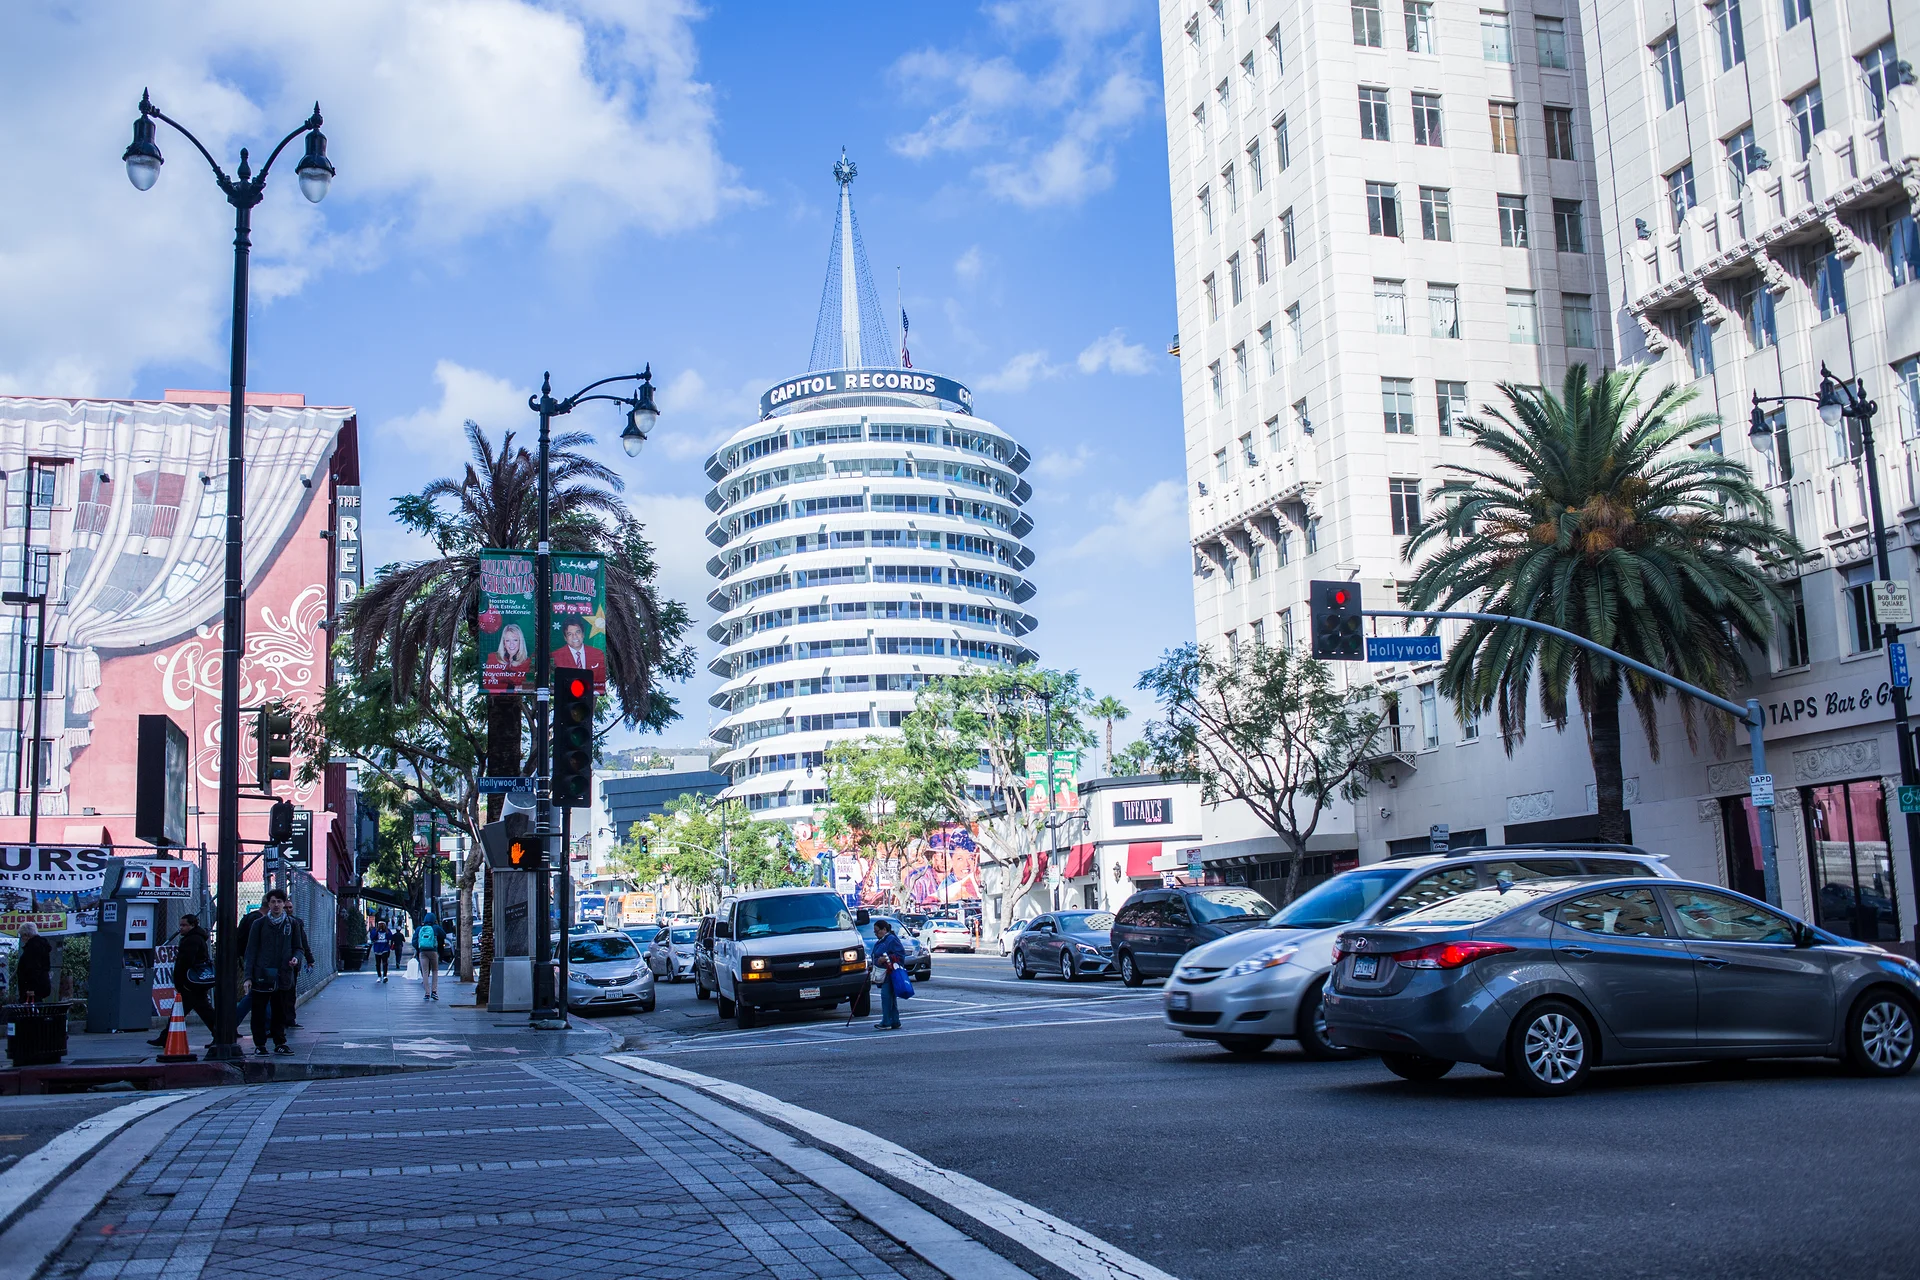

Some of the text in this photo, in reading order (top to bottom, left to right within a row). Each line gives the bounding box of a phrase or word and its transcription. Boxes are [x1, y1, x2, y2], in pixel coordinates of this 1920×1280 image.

[770, 373, 936, 405] CAPITOL RECORDS
[338, 495, 360, 508] THE
[480, 559, 533, 577] HOLLYWOOD
[480, 572, 535, 595] CHRISTMAS
[552, 572, 597, 598] PARADE
[1369, 642, 1439, 659] Hollywood
[482, 662, 507, 671] Sunday
[1897, 646, 1908, 684] SYNC
[1769, 677, 1913, 725] TAPS Bar & Grl
[479, 778, 532, 788] Hollywood Bl
[1750, 775, 1772, 784] LAPD
[1122, 800, 1162, 820] TIFFANY'S
[125, 871, 143, 879] ATM
[104, 903, 117, 911] ATM
[1, 914, 61, 923] TICKETS
[131, 919, 148, 927] ATM
